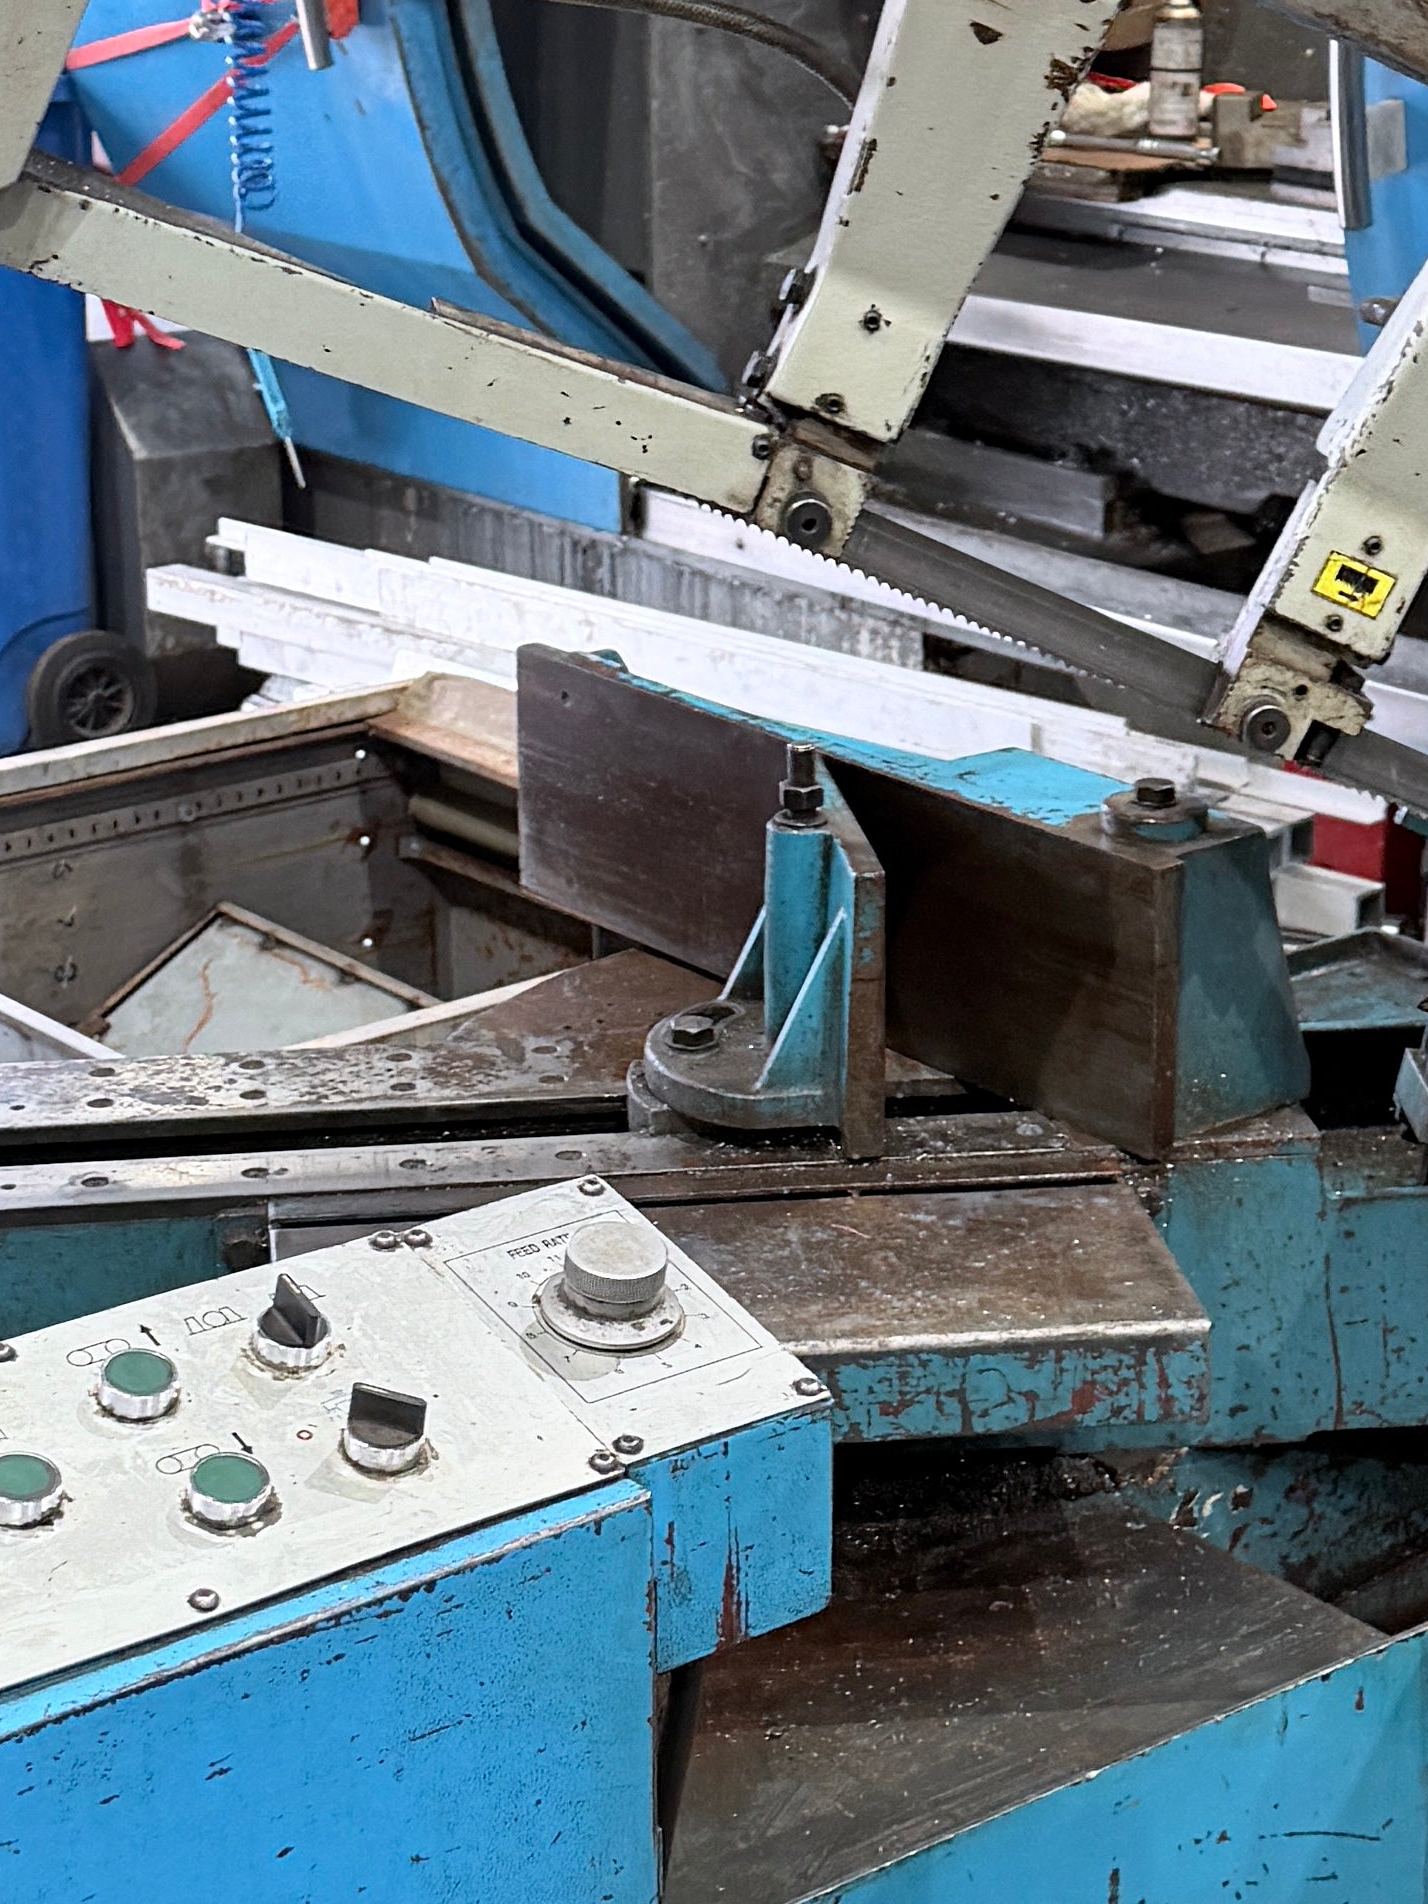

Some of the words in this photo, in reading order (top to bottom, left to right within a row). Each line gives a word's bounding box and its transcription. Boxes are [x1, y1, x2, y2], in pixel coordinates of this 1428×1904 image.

[507, 1244, 541, 1260] FEED
[547, 1255, 562, 1263] 11
[516, 1272, 531, 1280] 10
